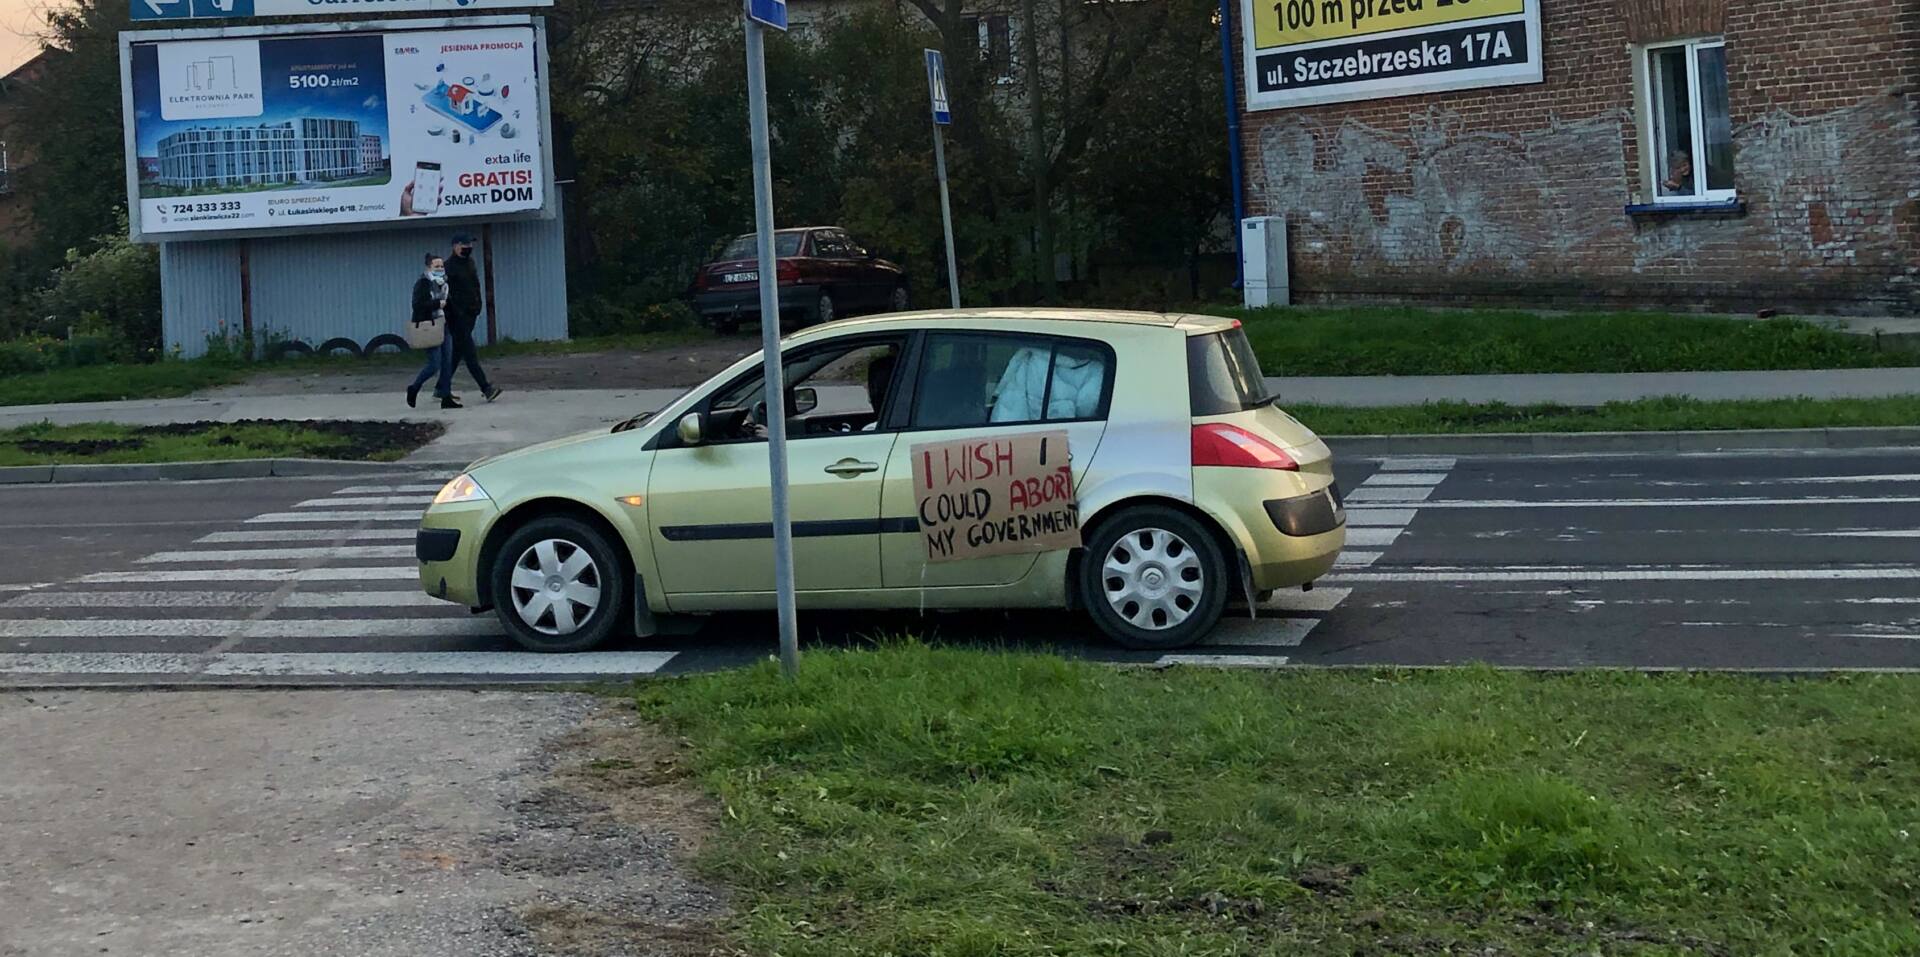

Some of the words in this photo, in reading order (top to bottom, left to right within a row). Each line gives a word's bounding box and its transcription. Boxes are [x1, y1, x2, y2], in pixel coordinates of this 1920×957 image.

[1273, 2, 1315, 31] 100
[1322, 3, 1344, 24] m
[441, 44, 478, 53] JESIENNA
[481, 42, 523, 50] PROMOCJA
[1266, 66, 1289, 86] ul.
[1294, 40, 1452, 83] Szczebrzeska
[1461, 30, 1512, 62] 17A
[289, 74, 329, 89] 5100
[169, 94, 230, 103] ELEKTROWNIA
[485, 154, 510, 165] exta
[513, 153, 531, 163] life
[459, 170, 532, 188] GRATIS!
[444, 193, 487, 206] SMART
[491, 187, 533, 203] DOM
[172, 204, 193, 213] 724
[196, 203, 217, 212] 333
[220, 201, 241, 211] 333
[924, 451, 933, 489] I
[944, 441, 1013, 485] WISH
[1039, 437, 1047, 466] I
[920, 488, 991, 526] COULD
[1010, 466, 1072, 511] ABORT
[927, 525, 956, 559] MY
[967, 504, 1079, 548] GOVERNMENT
